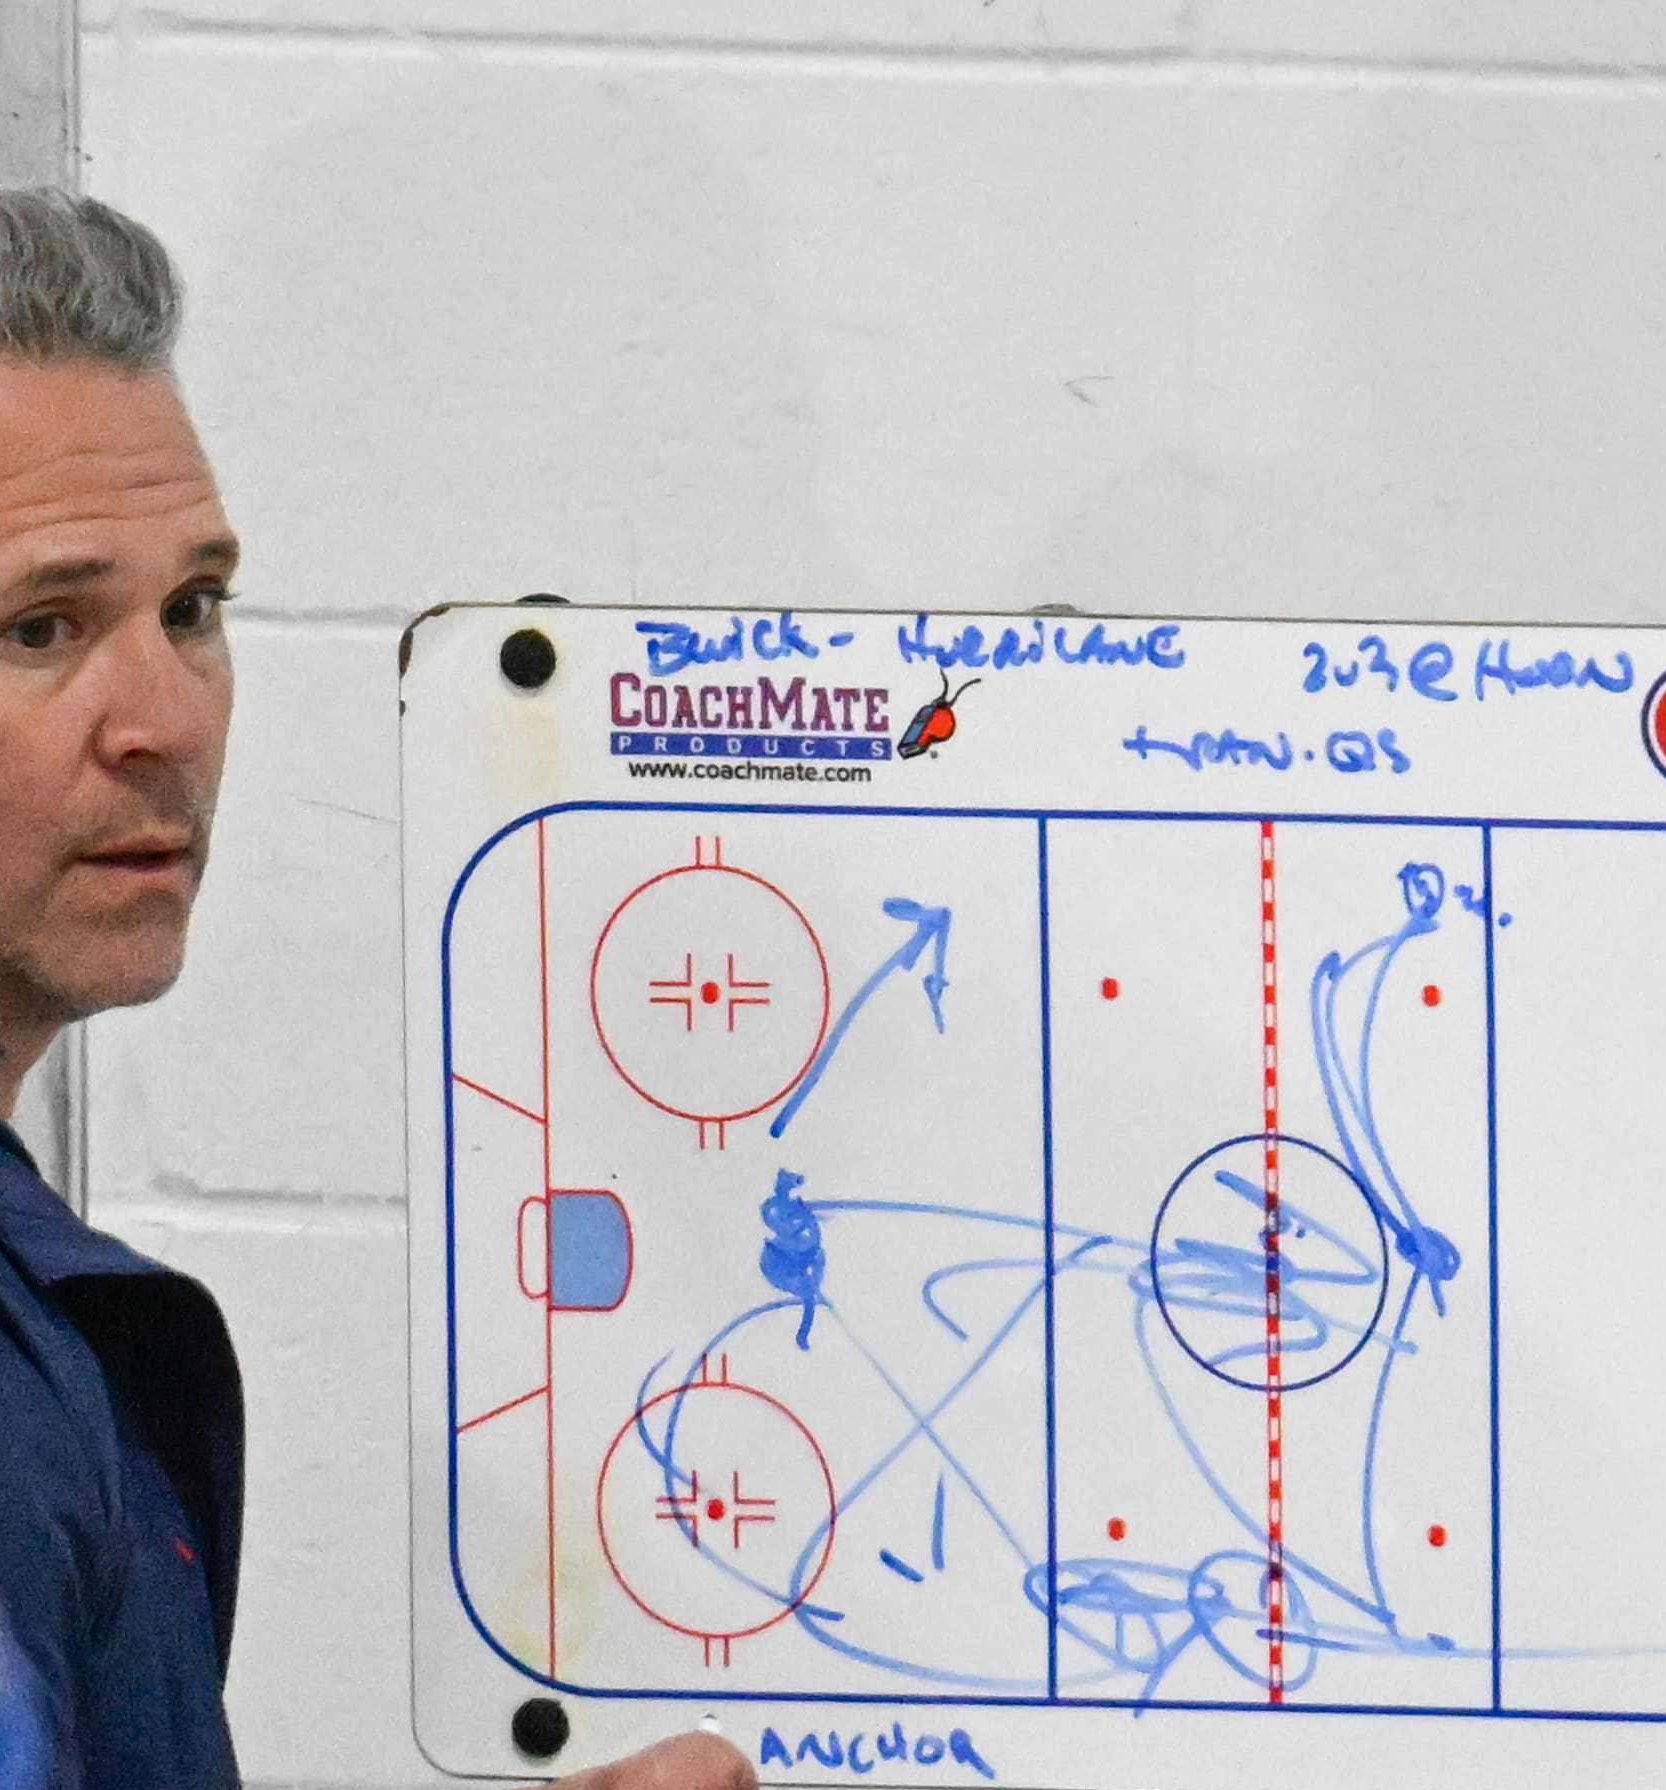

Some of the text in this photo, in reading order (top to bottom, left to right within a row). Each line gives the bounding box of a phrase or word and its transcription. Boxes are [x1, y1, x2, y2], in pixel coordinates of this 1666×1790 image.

[616, 734, 887, 758] PRODUCTS
[628, 759, 873, 783] www.coachmate.com
[760, 1722, 996, 1781] ANCHOR
